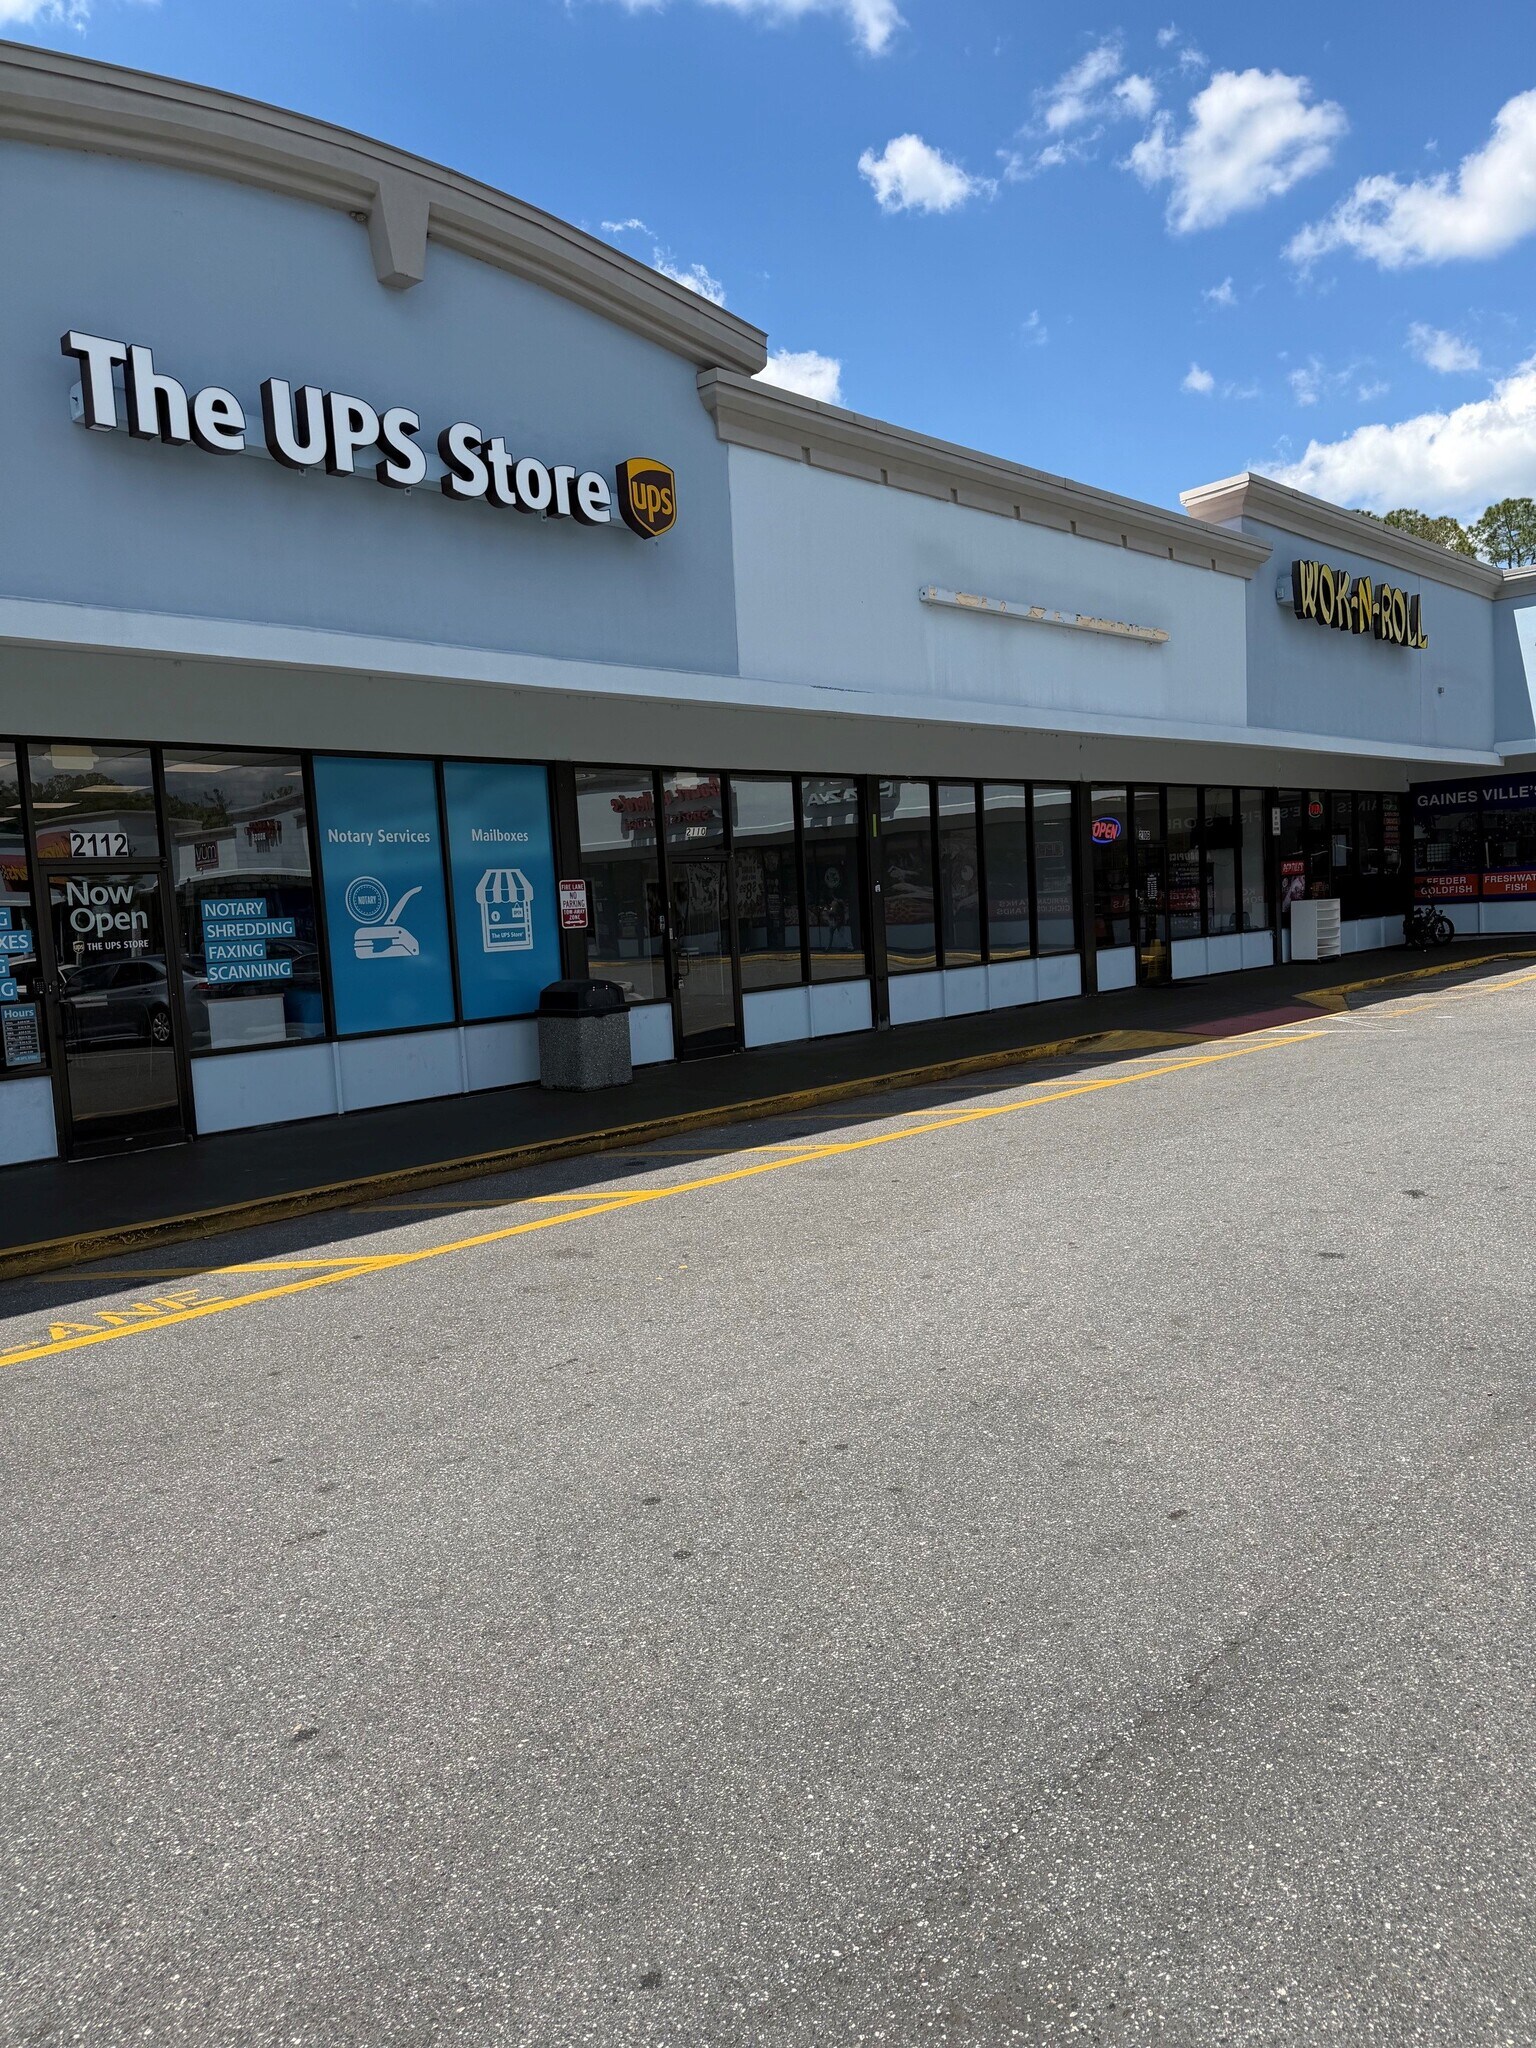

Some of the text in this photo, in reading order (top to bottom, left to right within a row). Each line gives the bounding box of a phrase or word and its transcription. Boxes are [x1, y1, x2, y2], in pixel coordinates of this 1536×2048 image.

[62, 330, 612, 526] The UPS Store
[632, 480, 675, 523] ups
[1292, 560, 1429, 649] WOK-N-ROLL
[1417, 784, 1536, 807] GAINES VILLE'
[328, 829, 431, 846] Notary Services
[471, 828, 529, 842] Mailboxes
[1091, 818, 1119, 840] OPEN
[72, 834, 127, 856] 2112
[1427, 876, 1467, 885] FEEDER
[1505, 883, 1528, 892] FISH
[66, 881, 134, 906] Now
[1421, 885, 1473, 895] GOLDFISH
[357, 895, 377, 905] NOTARY
[562, 900, 585, 908] PARKING
[204, 902, 263, 917] NOTARY
[70, 907, 149, 938] Open
[206, 921, 293, 938] SHREDDING
[491, 931, 500, 939] The
[87, 942, 103, 951] THE
[105, 941, 122, 950] UPS
[123, 939, 149, 949] STORE
[208, 943, 264, 960] FAXING
[209, 962, 291, 981] SCANNING
[4, 1009, 34, 1019] Hours
